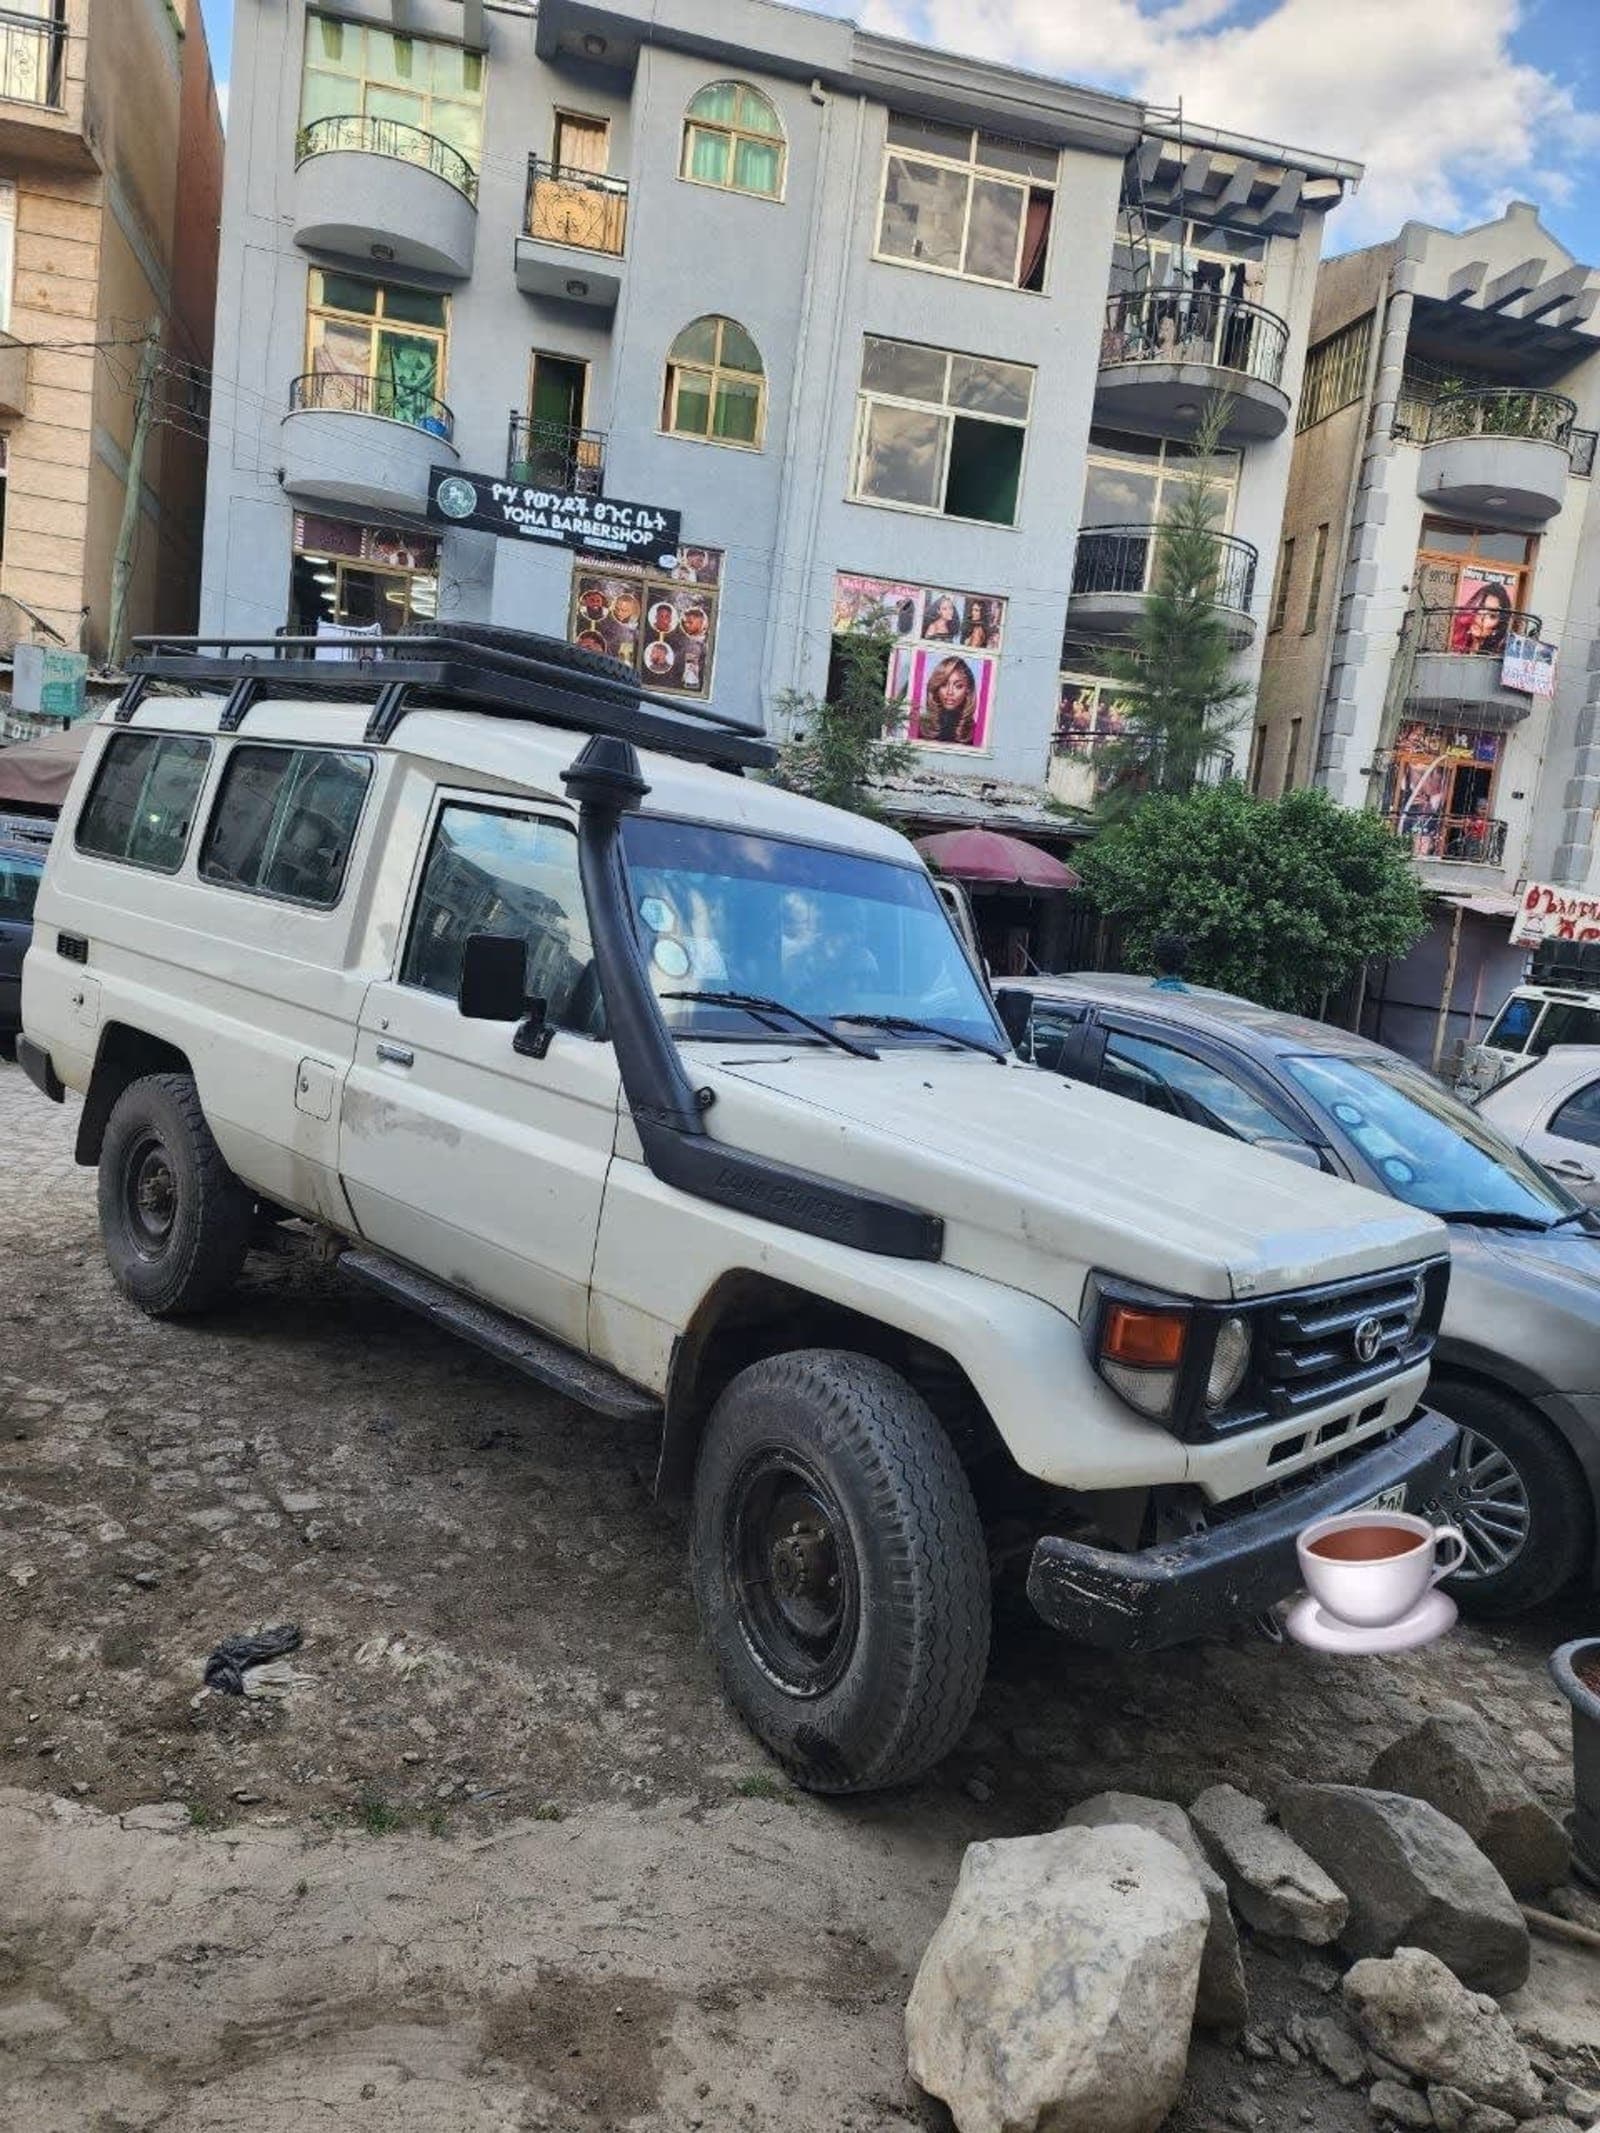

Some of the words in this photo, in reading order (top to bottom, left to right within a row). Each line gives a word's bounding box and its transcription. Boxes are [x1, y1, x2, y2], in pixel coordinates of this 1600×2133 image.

[502, 505, 547, 528] YOHA
[551, 514, 655, 546] BARBERSHOP
[593, 503, 633, 527] ፀጉር
[636, 511, 668, 532] ቤት
